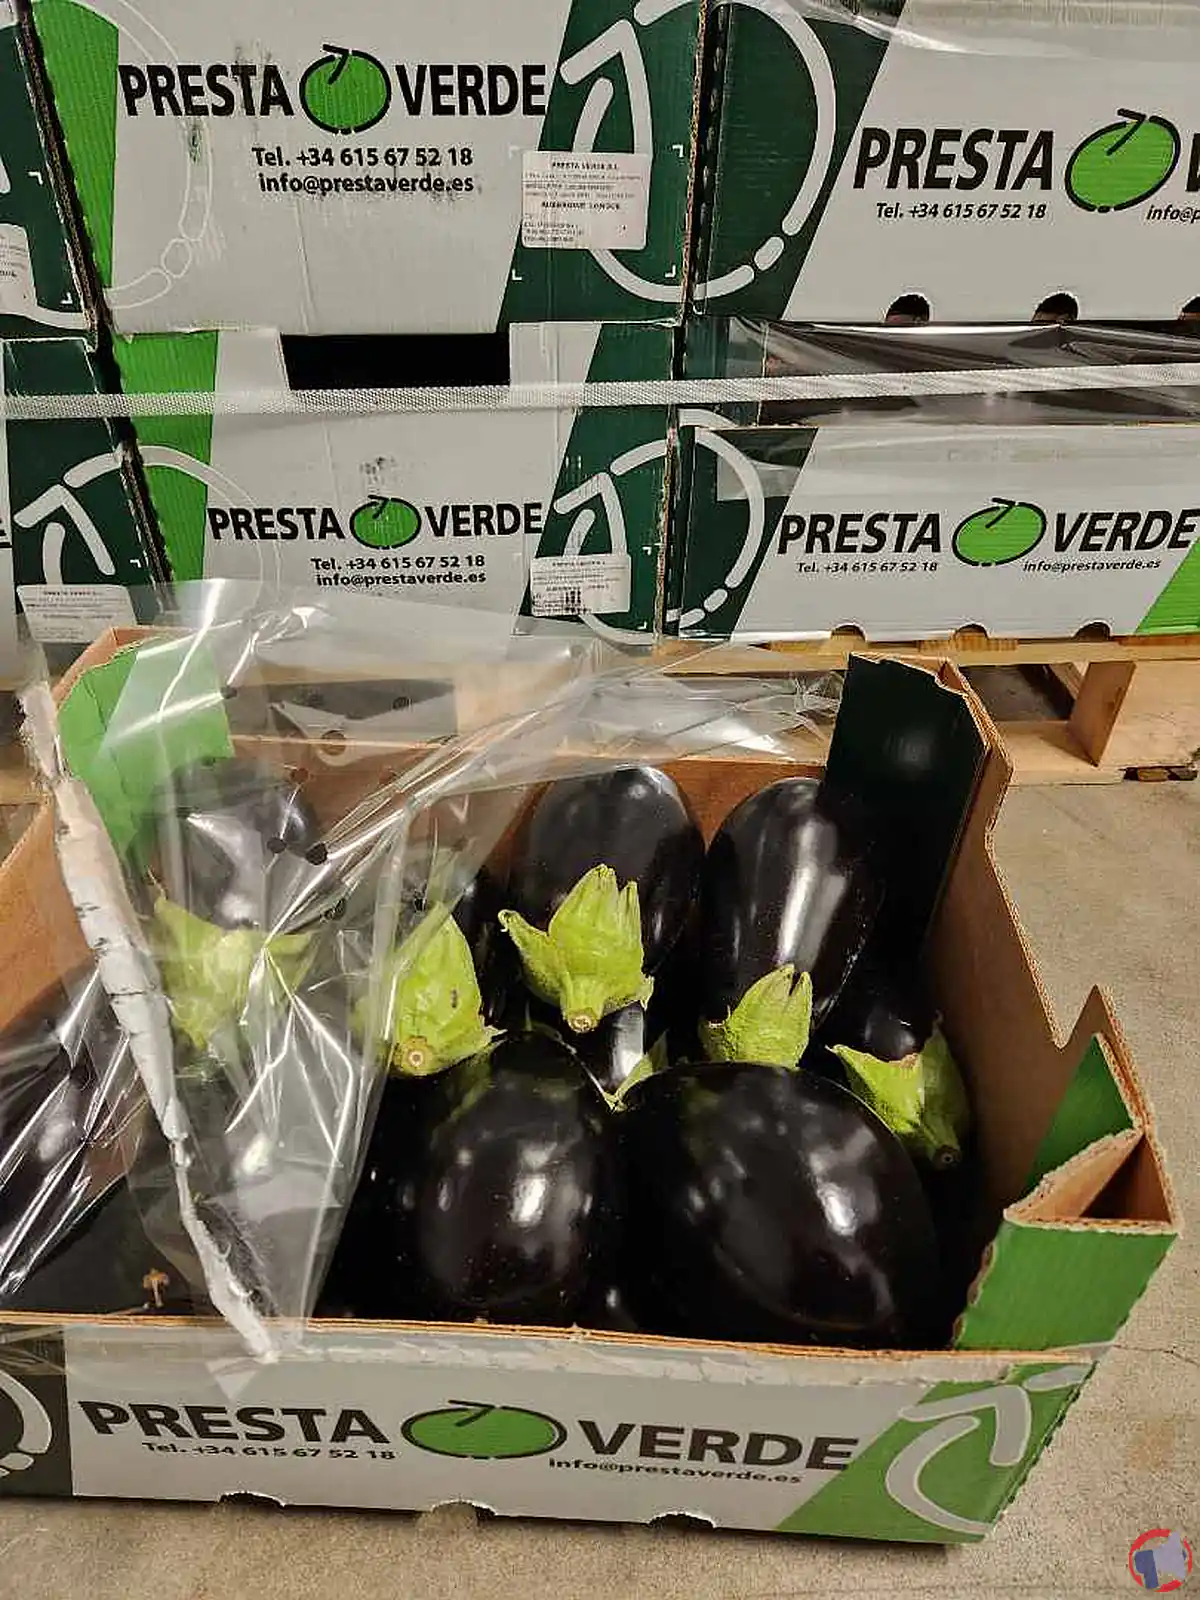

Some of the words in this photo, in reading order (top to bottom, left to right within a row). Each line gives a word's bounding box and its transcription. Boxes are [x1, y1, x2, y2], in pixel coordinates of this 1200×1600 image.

[119, 64, 295, 117] PRESTA
[396, 63, 547, 116] VERDE
[251, 147, 291, 167] Tel.
[296, 148, 335, 167] +34
[340, 148, 379, 167] 615
[384, 148, 410, 167] 67
[415, 148, 442, 167] 52
[447, 148, 474, 167] 18
[853, 128, 1053, 190] PRESTA
[258, 173, 475, 197] info@prestaverde.es
[876, 202, 904, 219] Tel.
[909, 203, 939, 219] +34
[943, 203, 974, 219] 615
[976, 203, 999, 219] 67
[1000, 203, 1022, 219] 52
[1028, 203, 1047, 219] 18
[208, 506, 345, 541] PRESTA
[424, 503, 543, 537] VERDE
[778, 514, 941, 555] PRESTA
[1054, 508, 1200, 552] VERDE
[310, 556, 343, 571] Tel.
[347, 556, 377, 570] +34
[380, 556, 412, 569] 615
[415, 556, 436, 569] 67
[440, 556, 461, 568] 52
[465, 555, 486, 567] 18
[797, 562, 819, 573] Tel.
[825, 562, 848, 573] +34
[851, 562, 877, 573] 615
[880, 562, 898, 573] 67
[900, 562, 918, 573] 52
[923, 562, 938, 573] 18
[1023, 559, 1162, 573] info@prestaverde.es
[316, 572, 487, 587] info@prestaverde.es
[78, 1400, 390, 1445] PRESTA
[577, 1419, 860, 1471] VERDE
[142, 1442, 188, 1454] Tel.
[193, 1445, 236, 1456] +34
[242, 1446, 288, 1458] 615
[292, 1448, 321, 1458] 67
[329, 1448, 359, 1459] 52
[367, 1449, 397, 1460] 18
[549, 1457, 801, 1484] info@prestaverde.es
